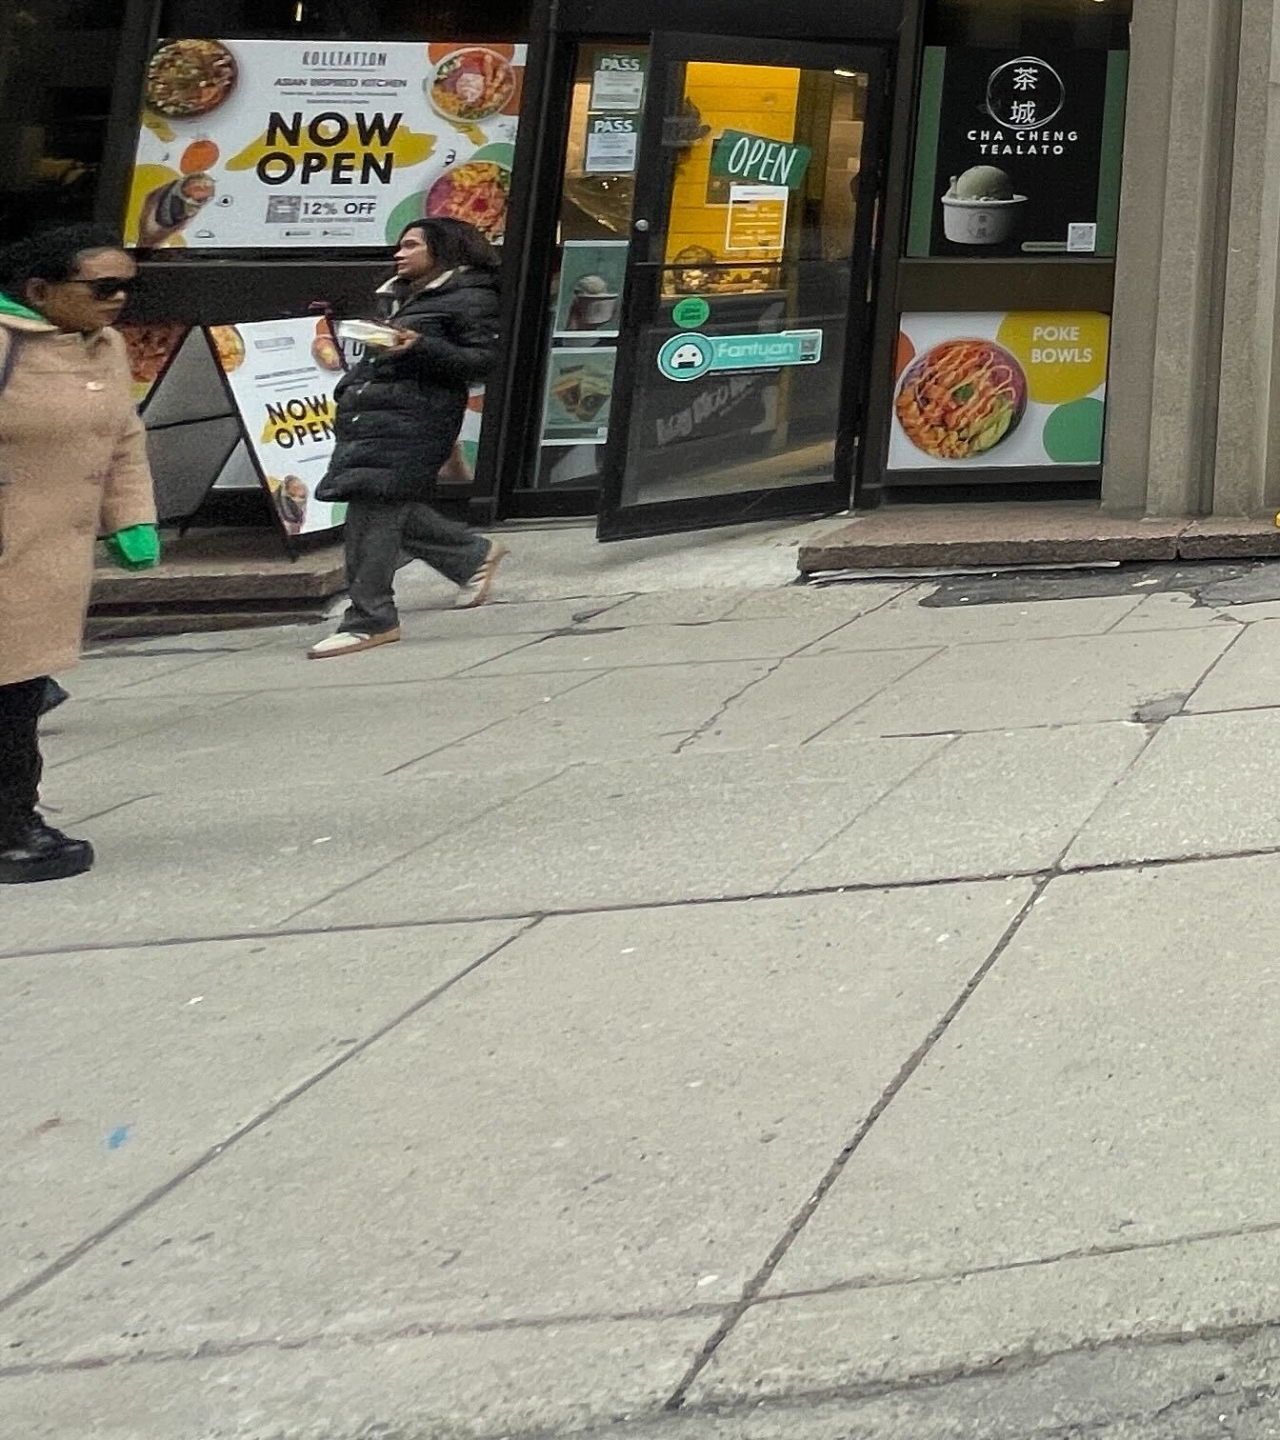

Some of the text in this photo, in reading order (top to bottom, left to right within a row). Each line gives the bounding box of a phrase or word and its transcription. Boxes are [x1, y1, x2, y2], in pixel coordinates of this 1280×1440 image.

[601, 58, 640, 71] PASS
[266, 112, 403, 147] NOW
[594, 120, 633, 133] PASS
[967, 131, 1079, 141] CHA CHENG
[980, 145, 1064, 155] TEALATO
[728, 137, 798, 184] OPEN
[257, 152, 394, 185] OPEN
[303, 202, 376, 215] 12% OFF
[1033, 326, 1080, 341] POKE
[1031, 348, 1092, 363] BOWLS
[265, 394, 329, 426] NOW
[275, 419, 336, 449] OPEN
